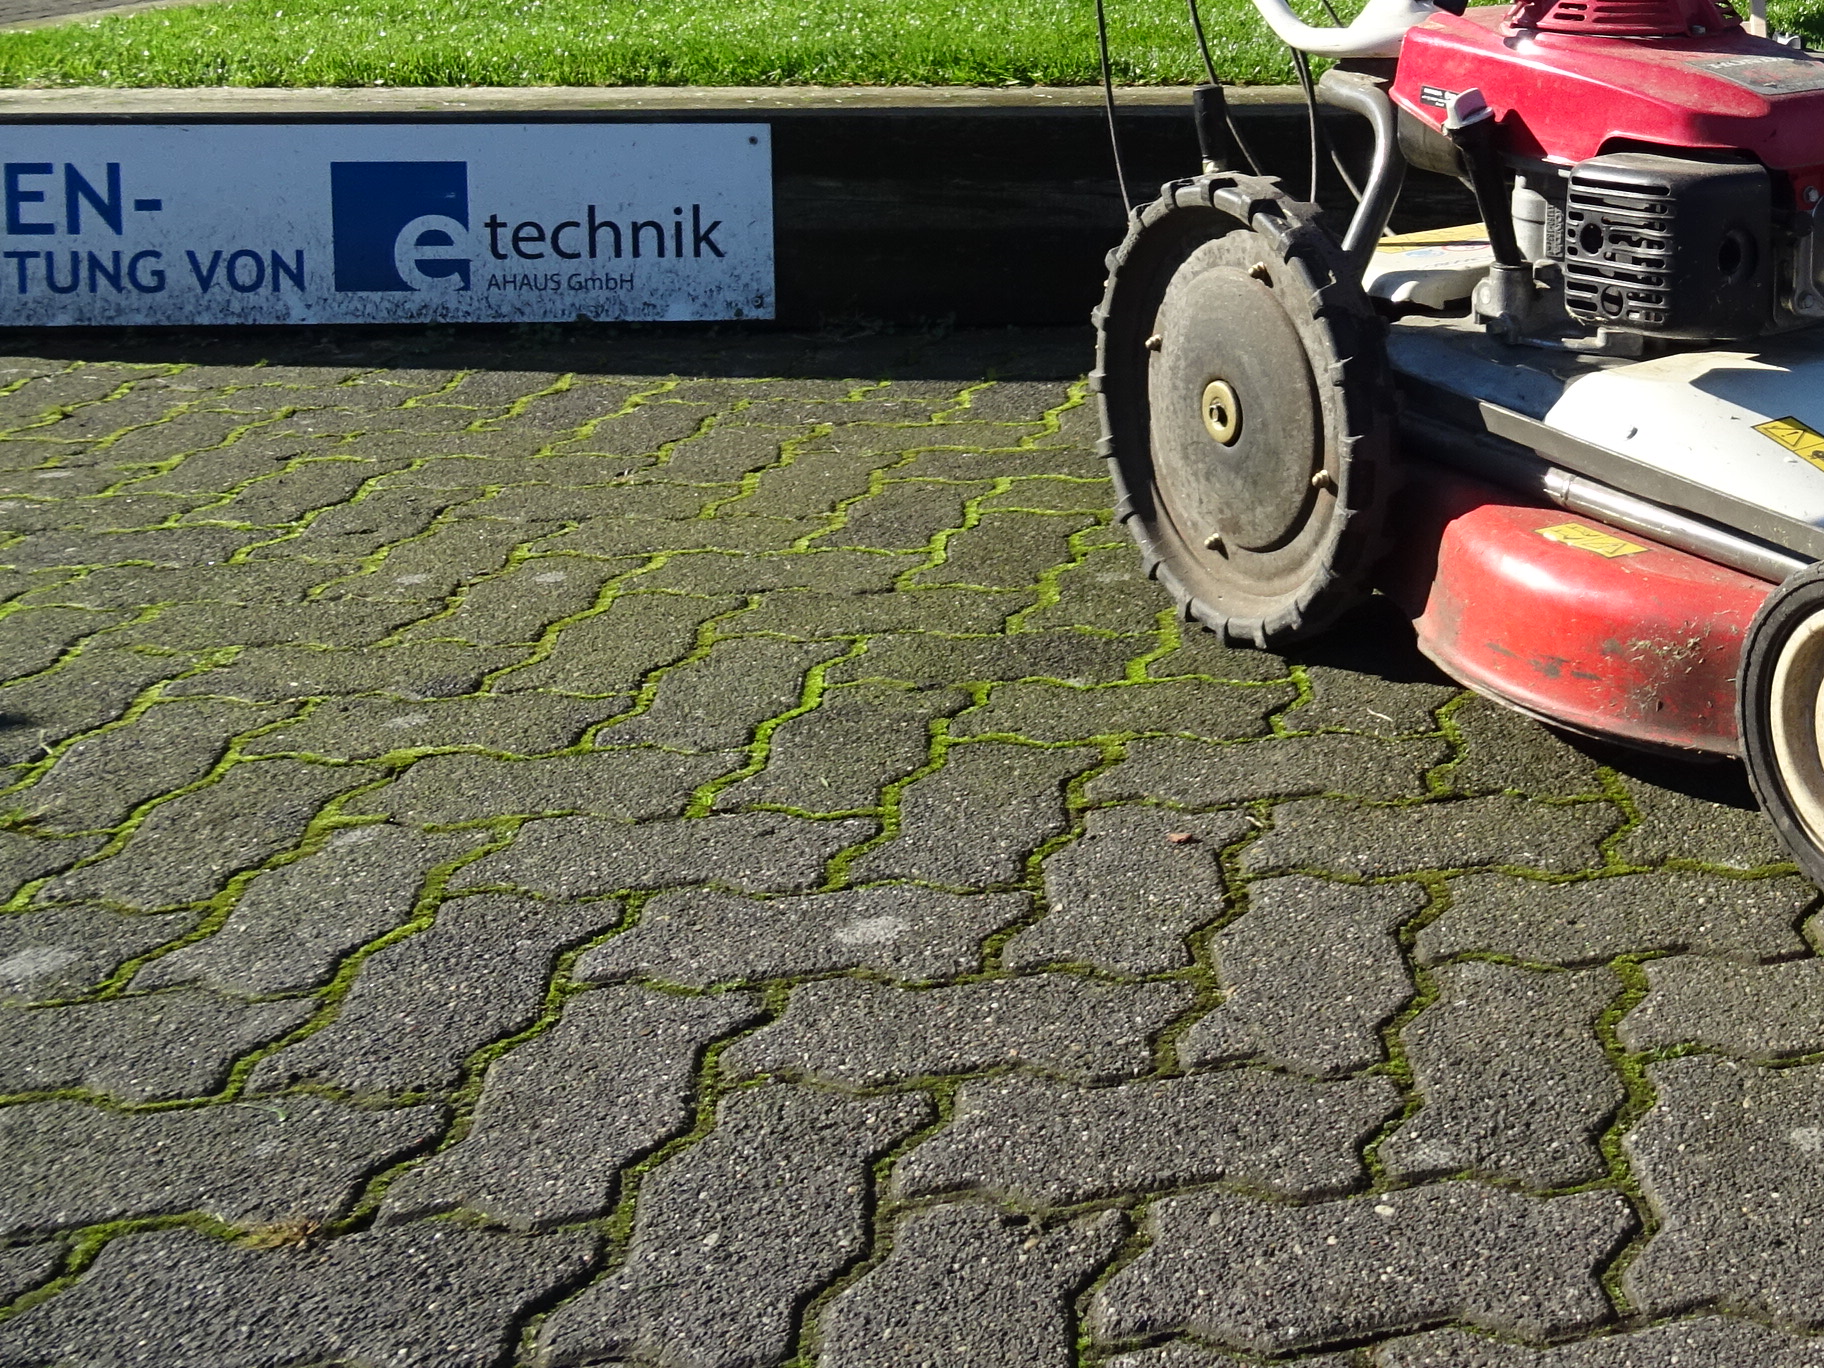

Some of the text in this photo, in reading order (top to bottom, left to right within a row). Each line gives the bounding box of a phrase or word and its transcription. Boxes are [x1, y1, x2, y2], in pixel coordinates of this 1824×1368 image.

[4, 162, 163, 236] EN-
[3, 249, 168, 295] TUNG
[184, 249, 307, 295] VON
[486, 271, 636, 293] AHAUS GmbH
